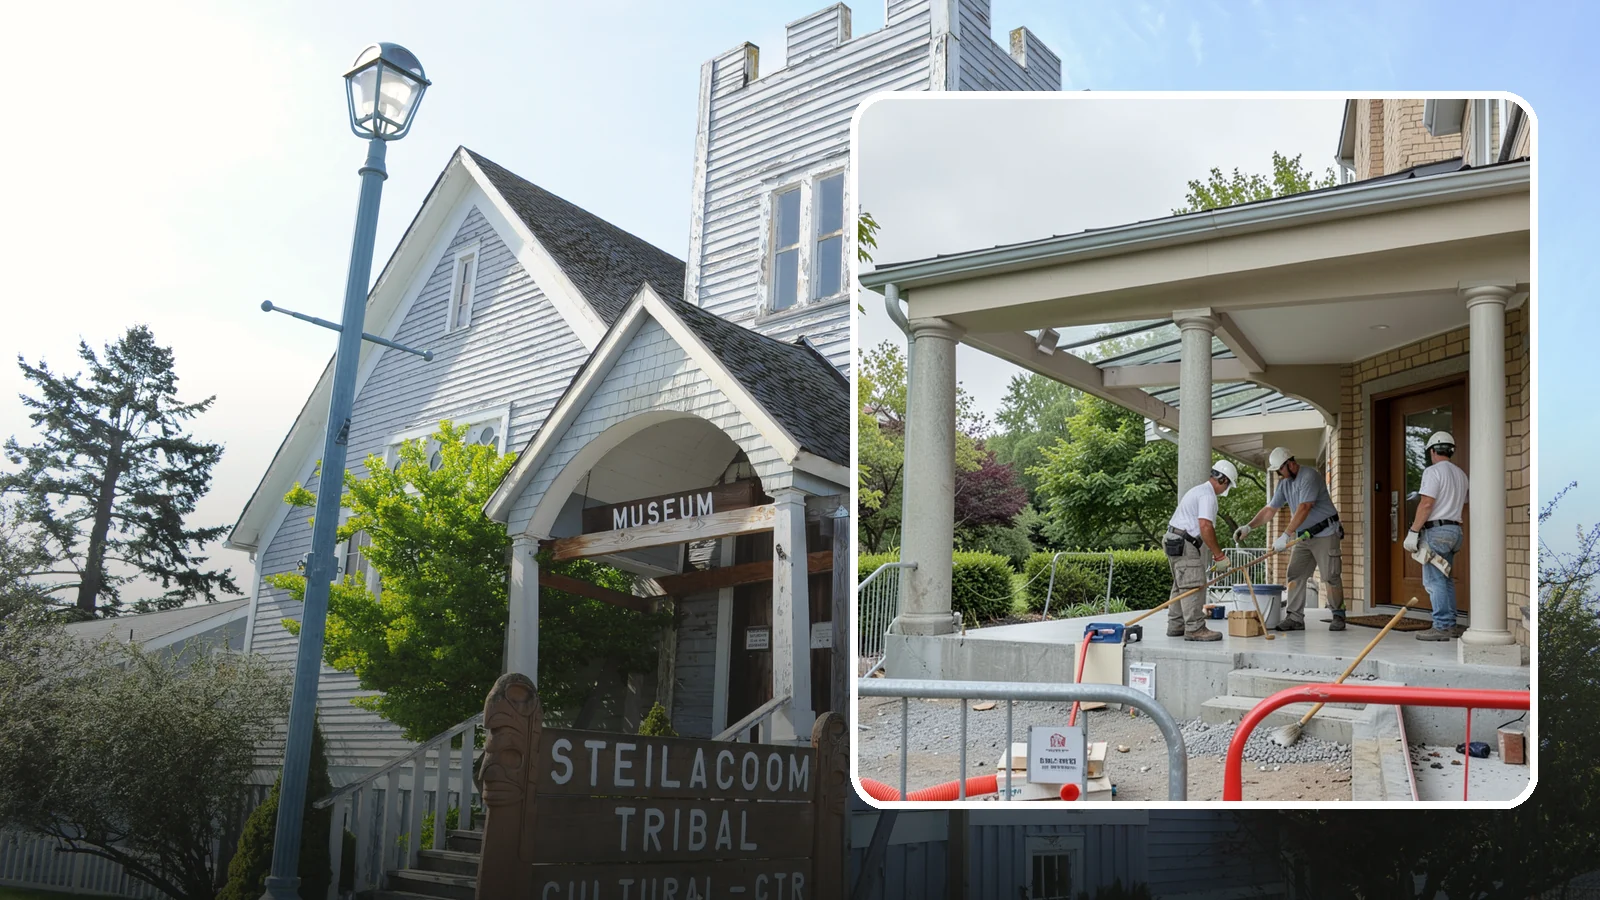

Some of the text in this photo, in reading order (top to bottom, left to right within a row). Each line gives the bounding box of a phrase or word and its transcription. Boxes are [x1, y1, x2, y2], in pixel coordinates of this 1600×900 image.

[613, 491, 713, 531] MUSEUM
[551, 738, 809, 792] STEILACOOM
[615, 806, 757, 851] TRIBAL
